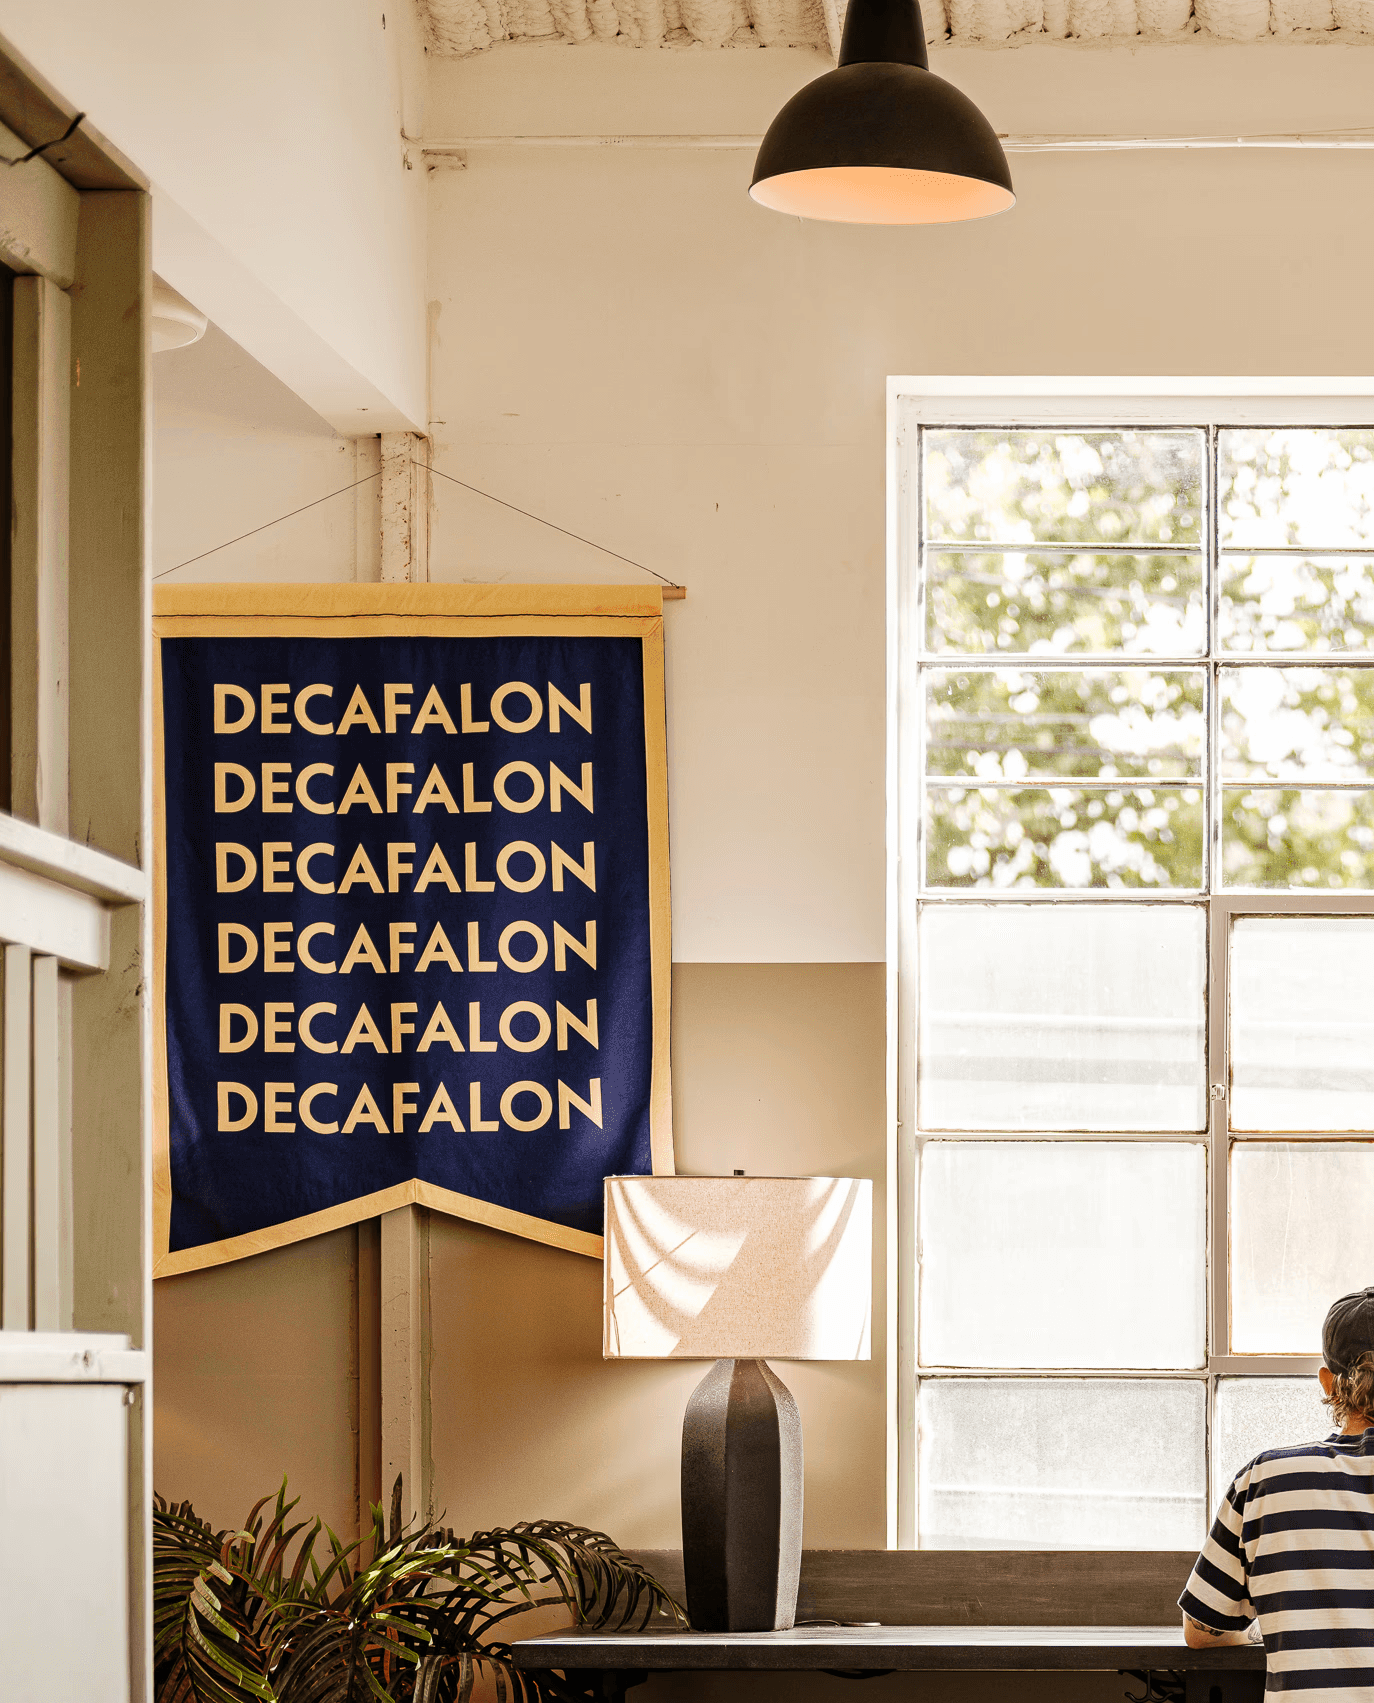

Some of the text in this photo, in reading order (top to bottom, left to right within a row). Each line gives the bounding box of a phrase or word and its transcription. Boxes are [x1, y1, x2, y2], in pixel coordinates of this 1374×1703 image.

[214, 681, 593, 735] DECAFALON
[215, 760, 594, 814] DECAFALON
[216, 840, 597, 894] DECAFALON
[218, 920, 597, 974] DECAFALON
[219, 999, 599, 1053] DECAFALON
[218, 1078, 603, 1134] DECAFALON
